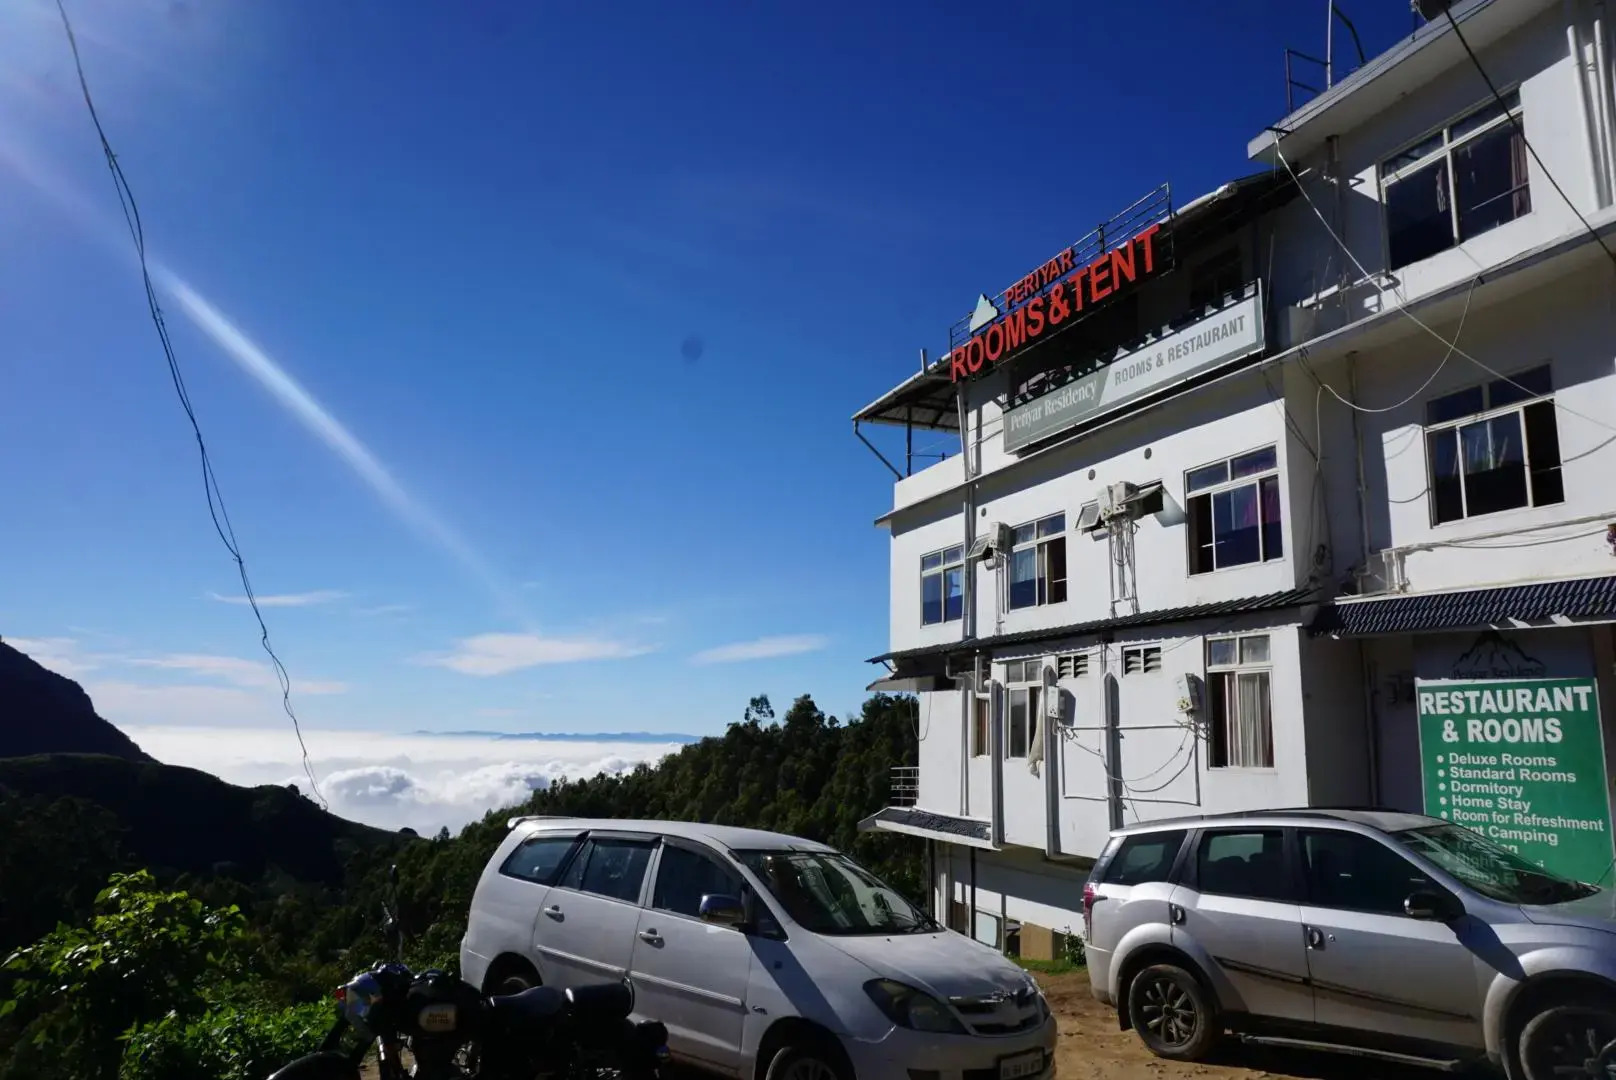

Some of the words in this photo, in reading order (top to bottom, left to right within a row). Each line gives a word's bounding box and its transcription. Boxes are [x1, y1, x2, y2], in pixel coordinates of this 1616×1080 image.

[1004, 248, 1075, 309] PERIYAR
[1114, 357, 1153, 386] ROOMS
[1156, 352, 1165, 368] &
[1167, 315, 1245, 363] RESTAURANT
[1011, 406, 1042, 431] Periyar
[1044, 380, 1097, 416] Residency
[1420, 685, 1592, 715] RESTAURANT
[1442, 719, 1459, 743] &
[1467, 718, 1563, 743] ROOMS
[1449, 752, 1497, 766] Deluxe
[1501, 753, 1557, 767] Rooms
[1449, 767, 1515, 781] Standard
[1520, 769, 1576, 783] Rooms
[1451, 781, 1523, 798] Dormitory
[1452, 795, 1493, 809] Home
[1498, 797, 1531, 813] Stay
[1453, 809, 1488, 822] Room
[1491, 811, 1510, 825] for
[1513, 813, 1604, 831] Refreshment
[1488, 825, 1558, 846] Camping
